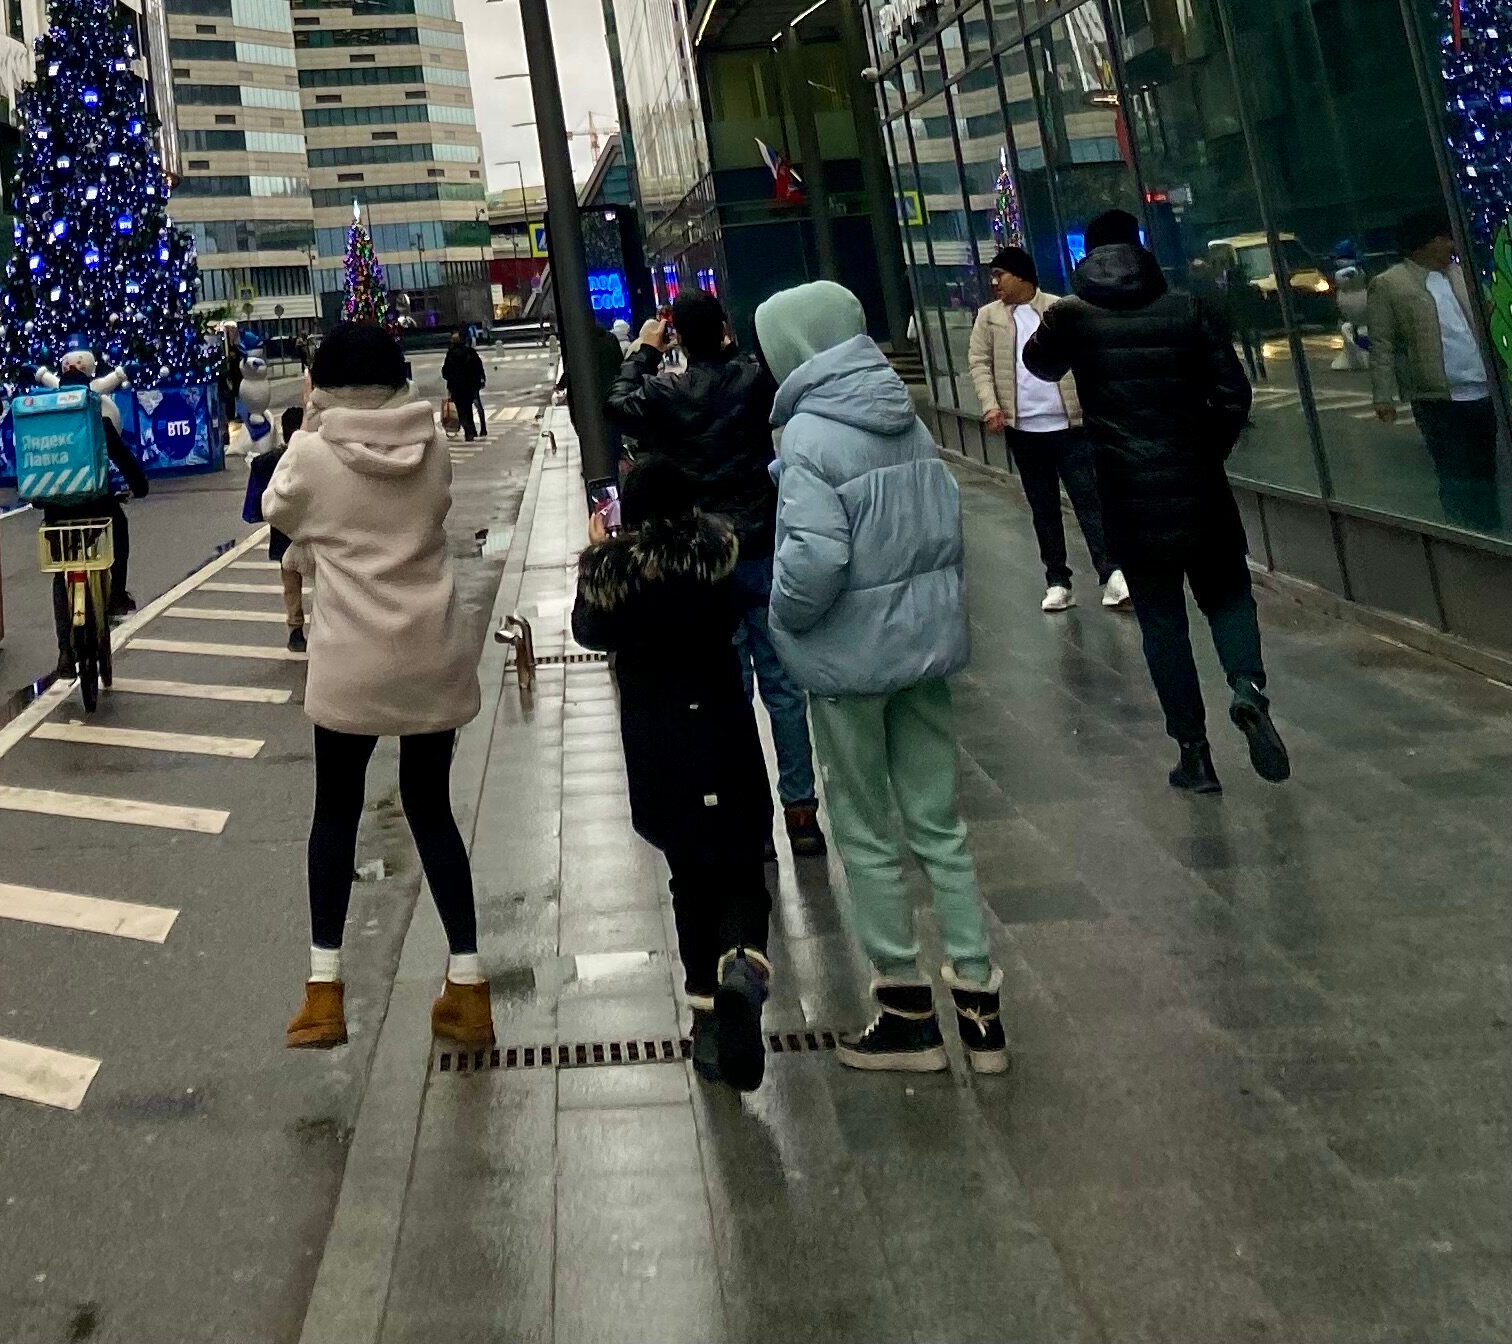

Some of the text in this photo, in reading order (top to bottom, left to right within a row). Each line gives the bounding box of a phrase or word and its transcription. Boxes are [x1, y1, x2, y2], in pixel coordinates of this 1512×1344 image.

[168, 420, 190, 436] ВТБ
[22, 433, 74, 451] Яндекс
[23, 452, 69, 468] Лавка
